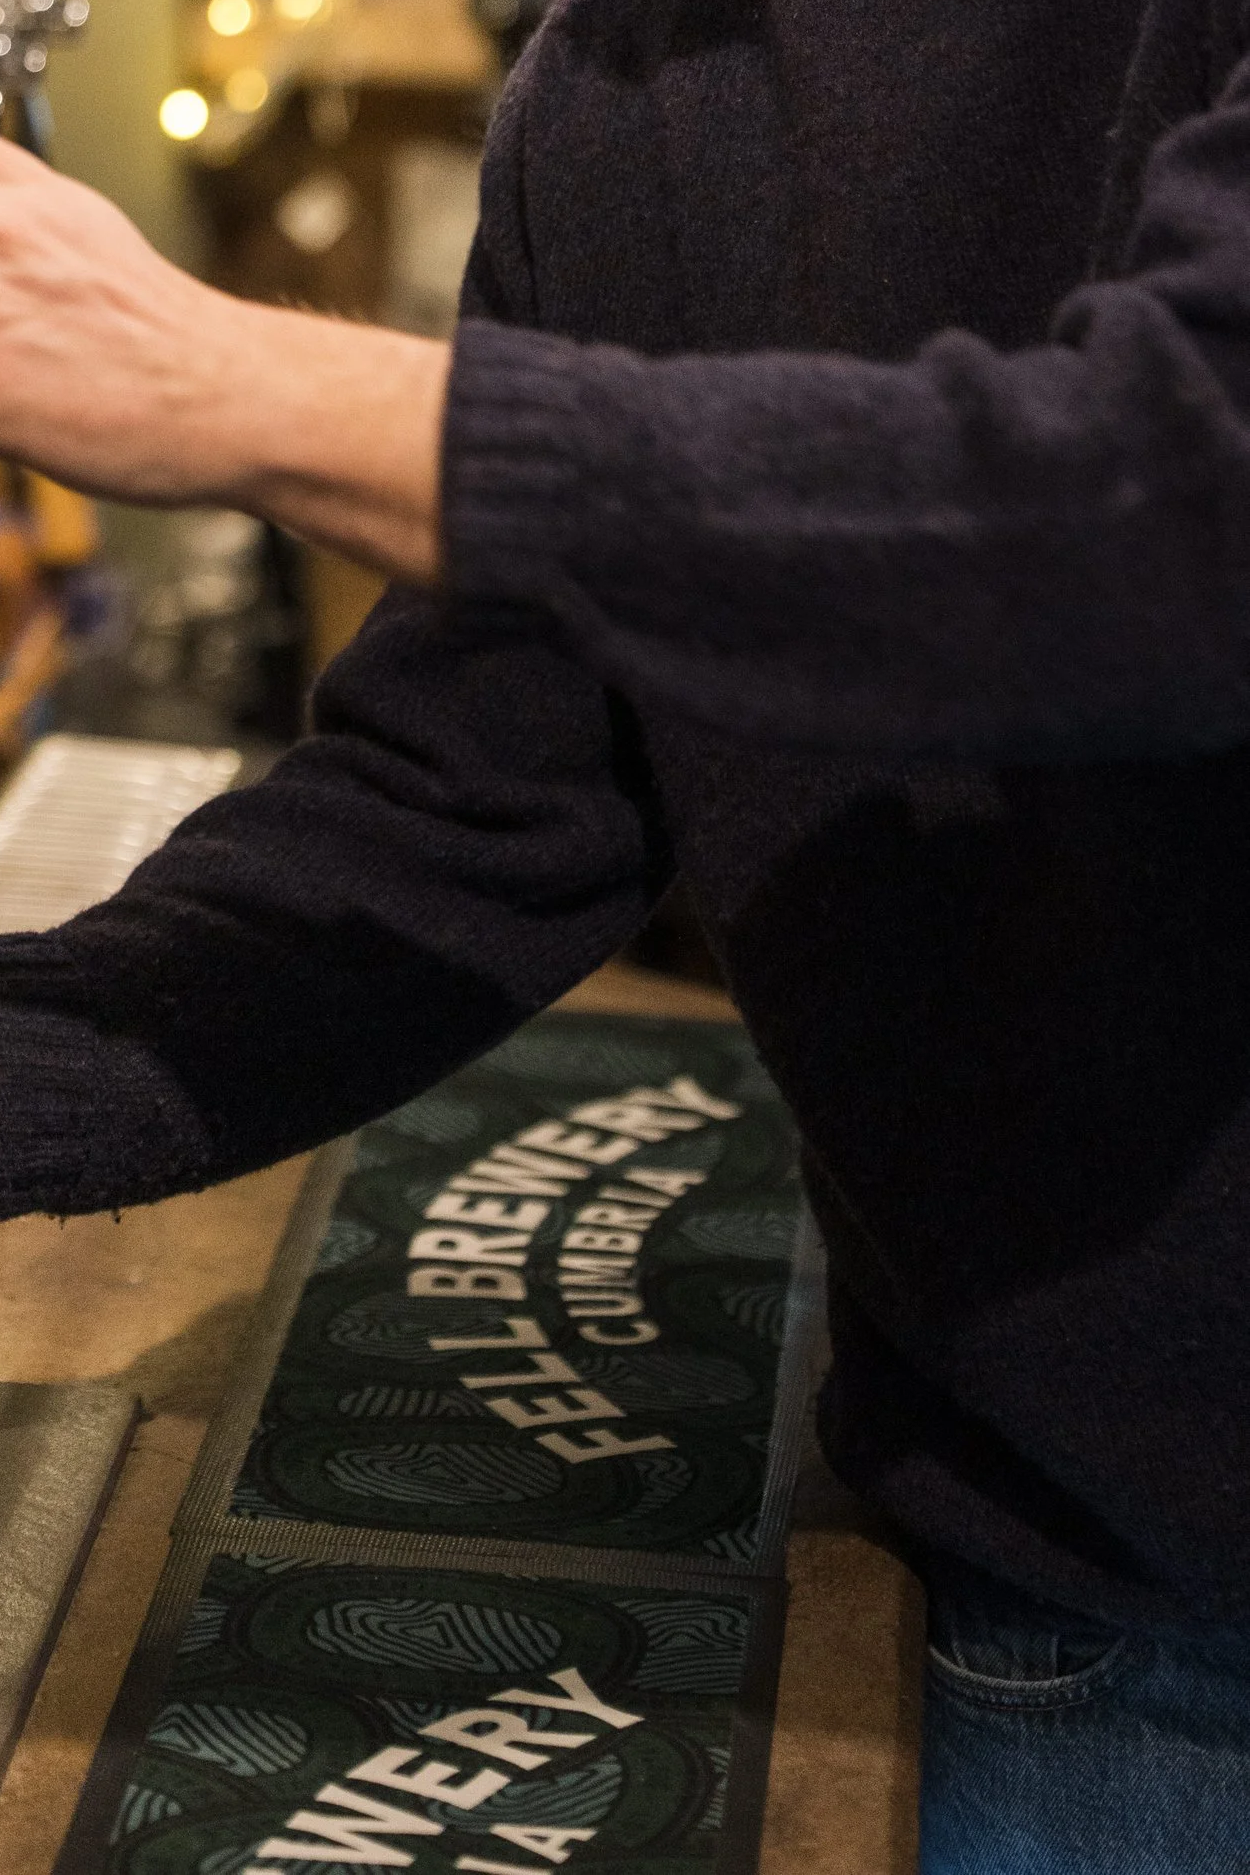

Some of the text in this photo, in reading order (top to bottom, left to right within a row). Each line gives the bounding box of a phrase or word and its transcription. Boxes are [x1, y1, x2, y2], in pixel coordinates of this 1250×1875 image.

[405, 1075, 743, 1466] FELL BREWERY
[557, 1167, 709, 1347] CUMBRIA
